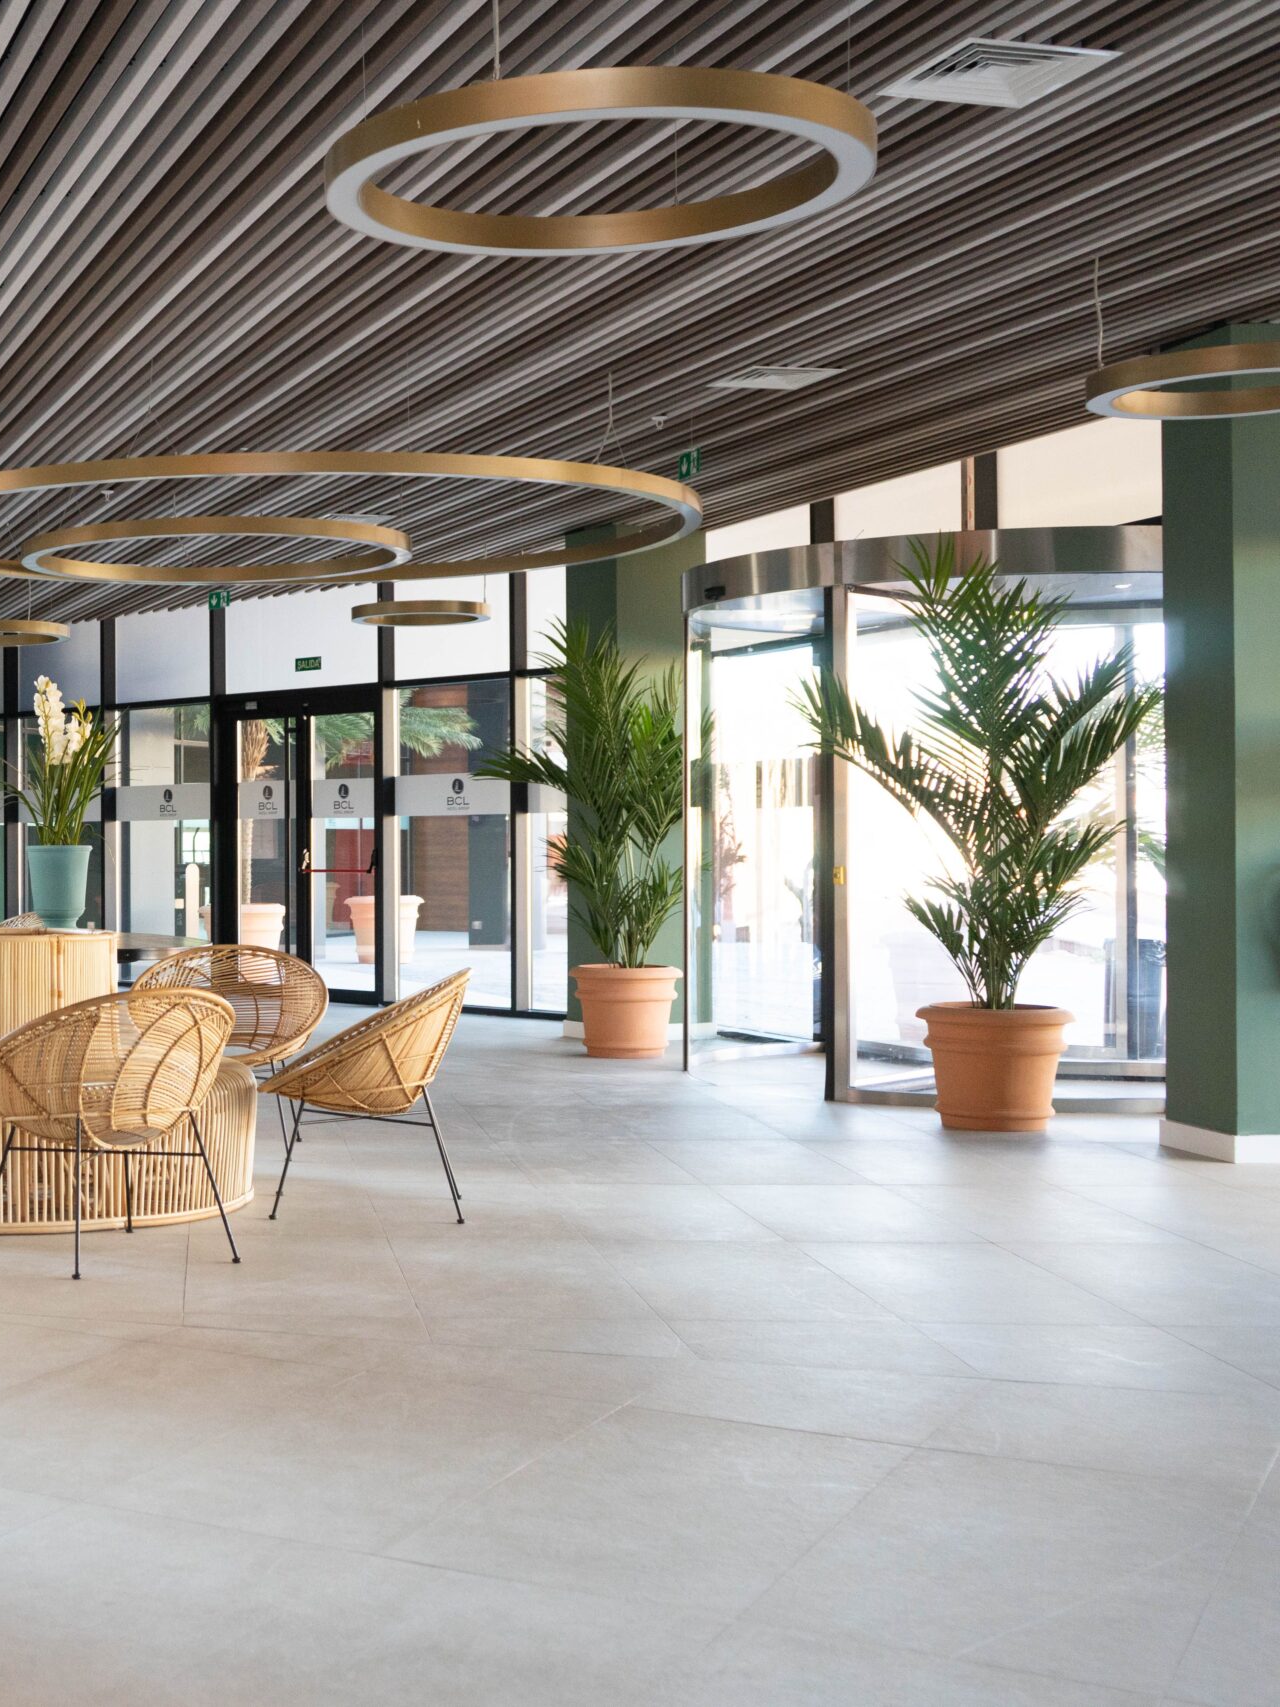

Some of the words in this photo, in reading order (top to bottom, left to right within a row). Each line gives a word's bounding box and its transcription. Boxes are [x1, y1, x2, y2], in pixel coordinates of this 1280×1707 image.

[297, 658, 320, 670] SALIDA
[258, 801, 278, 811] BCL
[333, 800, 355, 810] BCL
[446, 796, 470, 806] BCL
[159, 804, 177, 813] BCL
